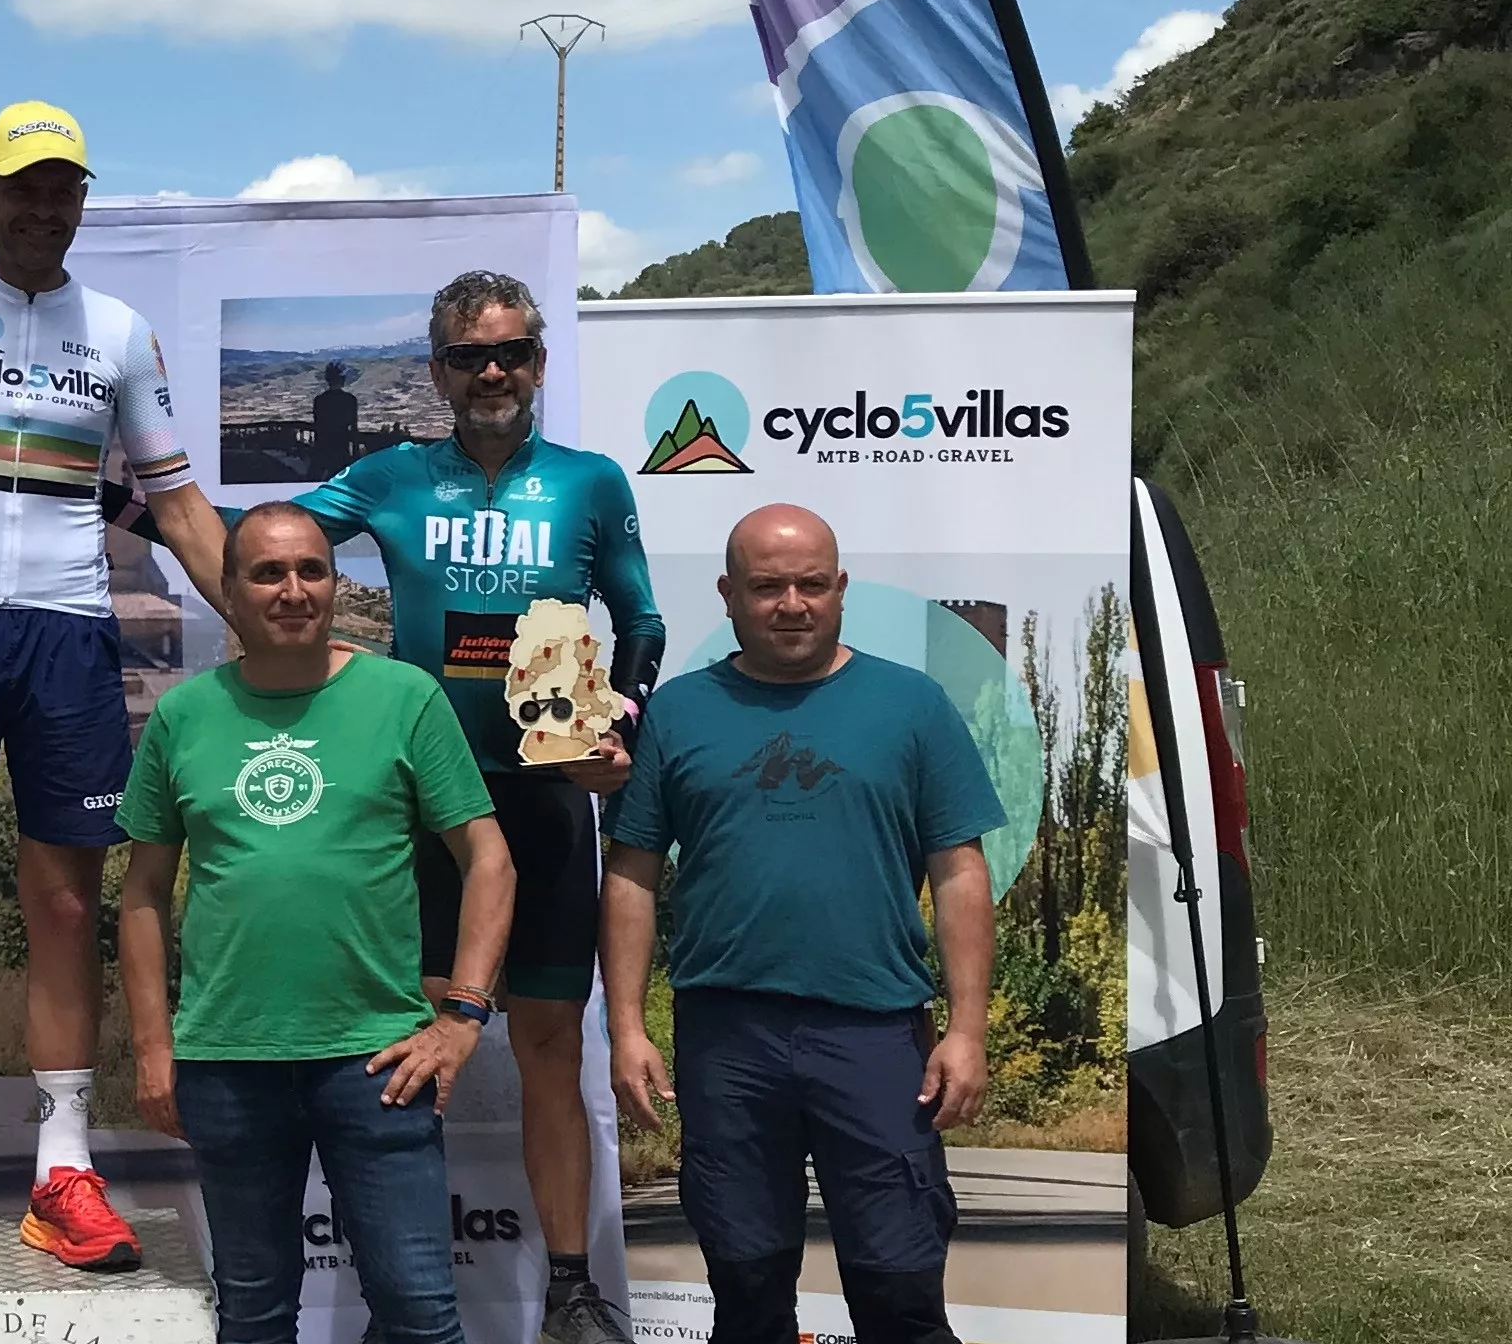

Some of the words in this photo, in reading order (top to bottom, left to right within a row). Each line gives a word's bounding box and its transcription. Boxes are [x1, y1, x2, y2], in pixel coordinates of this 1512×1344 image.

[763, 389, 1070, 454] cyclo5villas
[817, 450, 860, 463] MTB
[872, 450, 925, 463] ROAD
[937, 449, 1014, 463] GRAVEL
[425, 508, 555, 568] PEDAL
[444, 565, 540, 595] STORE
[251, 759, 309, 778] FORECAST
[254, 799, 304, 816] MCMXCI
